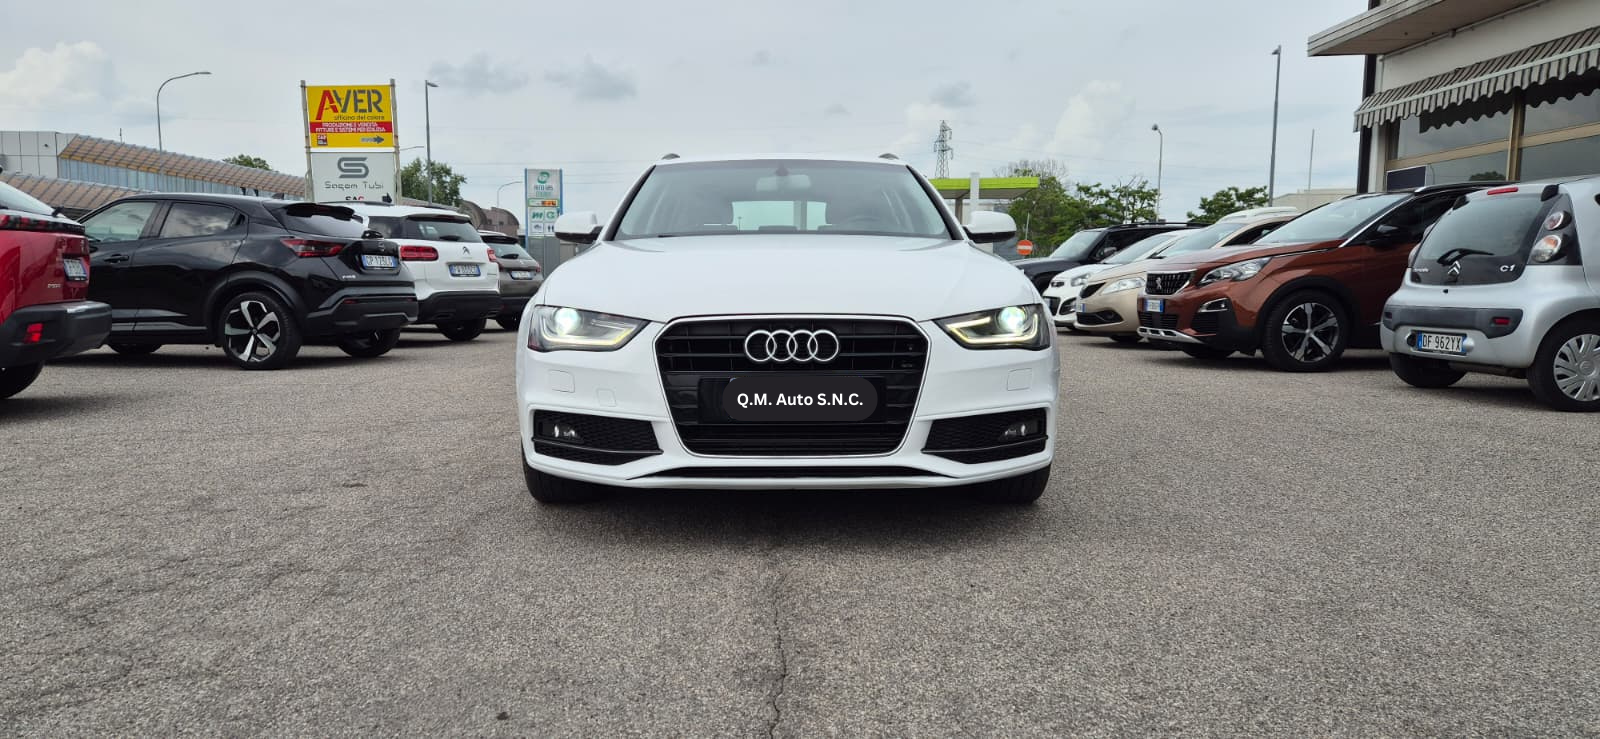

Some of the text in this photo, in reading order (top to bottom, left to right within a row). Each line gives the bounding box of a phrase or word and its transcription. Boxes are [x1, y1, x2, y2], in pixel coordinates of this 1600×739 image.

[316, 90, 383, 120] AVER
[362, 181, 384, 189] Tubi
[1499, 264, 1516, 272] C1
[1422, 334, 1461, 352] DF 962YX
